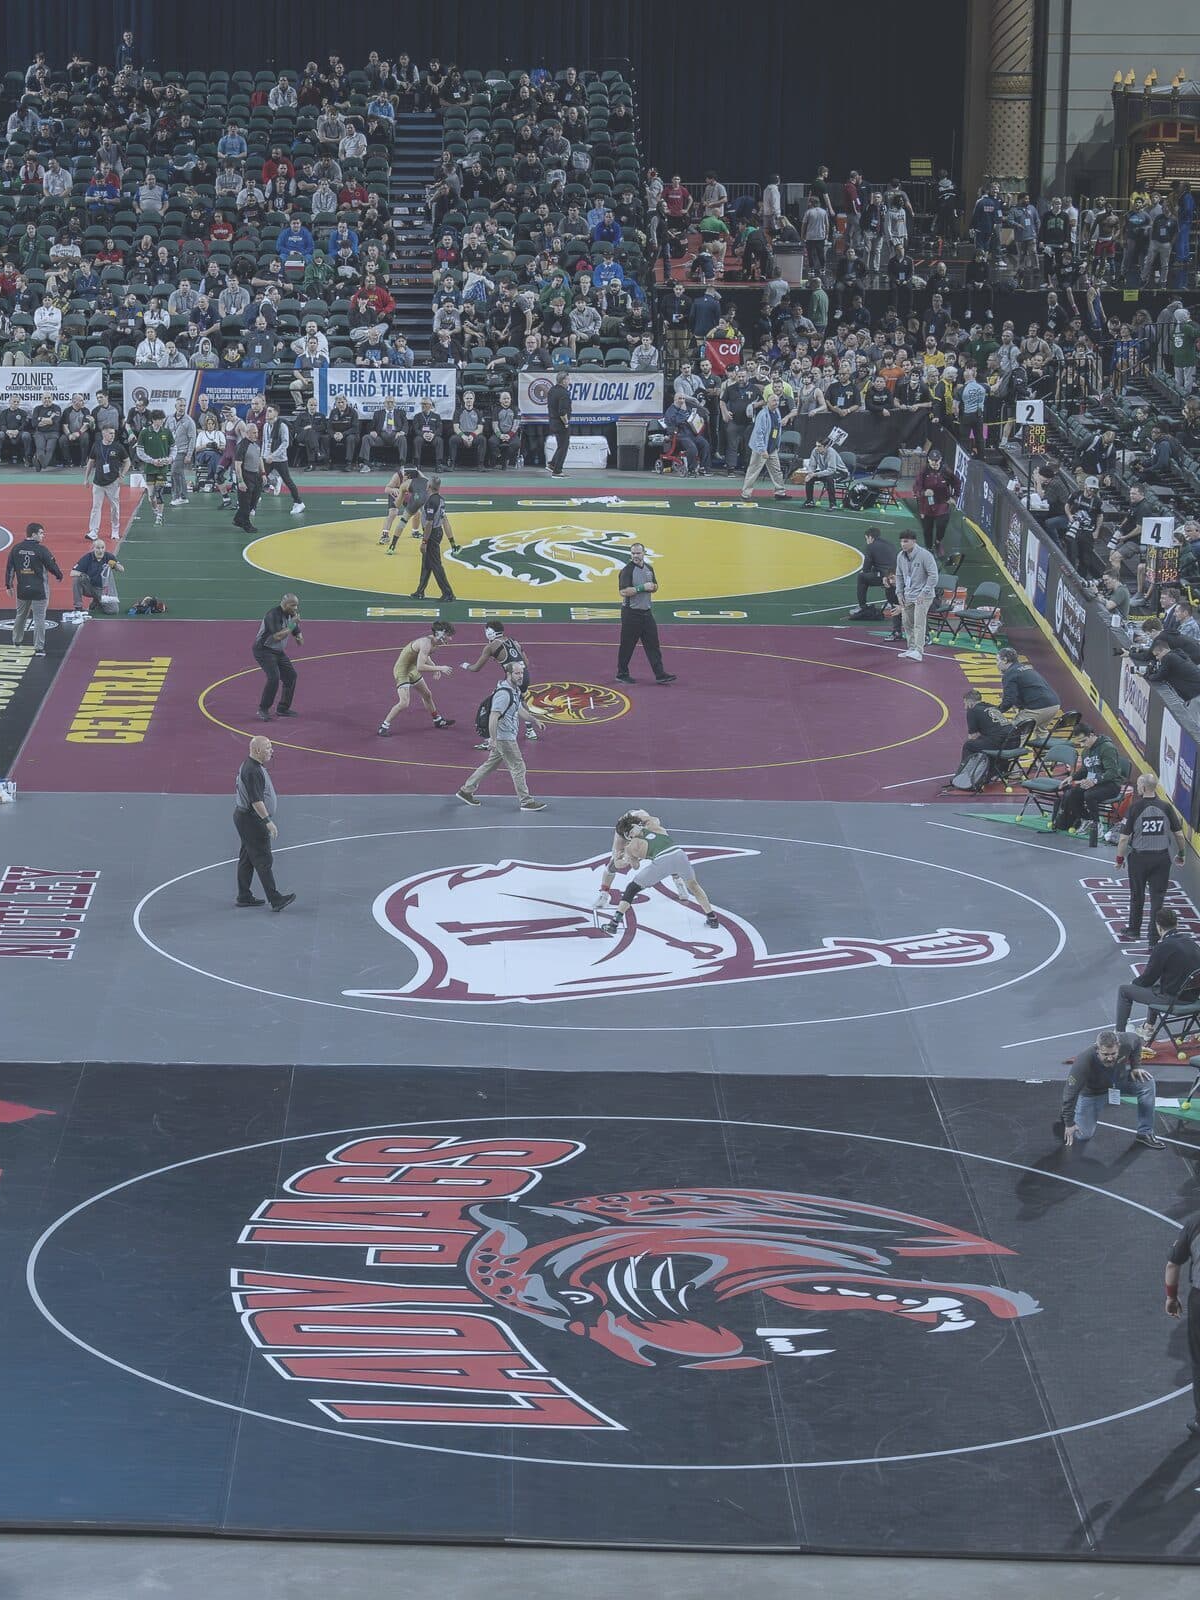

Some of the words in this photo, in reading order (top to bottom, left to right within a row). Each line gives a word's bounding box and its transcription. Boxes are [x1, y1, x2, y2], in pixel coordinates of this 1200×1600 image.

[719, 343, 741, 356] CO
[10, 372, 54, 386] ZOLNIER
[350, 370, 365, 383] BE
[368, 370, 377, 383] A
[380, 370, 432, 384] WINNER
[150, 389, 182, 398] IBEW
[329, 383, 377, 397] BEHIND
[381, 384, 403, 397] THE
[407, 384, 449, 397] WHEEL
[568, 383, 591, 401] BEW
[592, 382, 629, 401] LOCAL
[633, 382, 655, 401] 102
[1025, 404, 1035, 422] 2
[1150, 523, 1162, 544] 4
[65, 656, 172, 744] CENTRAL
[1141, 820, 1165, 834] 237
[236, 1135, 587, 1267] JAGS
[230, 1267, 630, 1432] LADY
